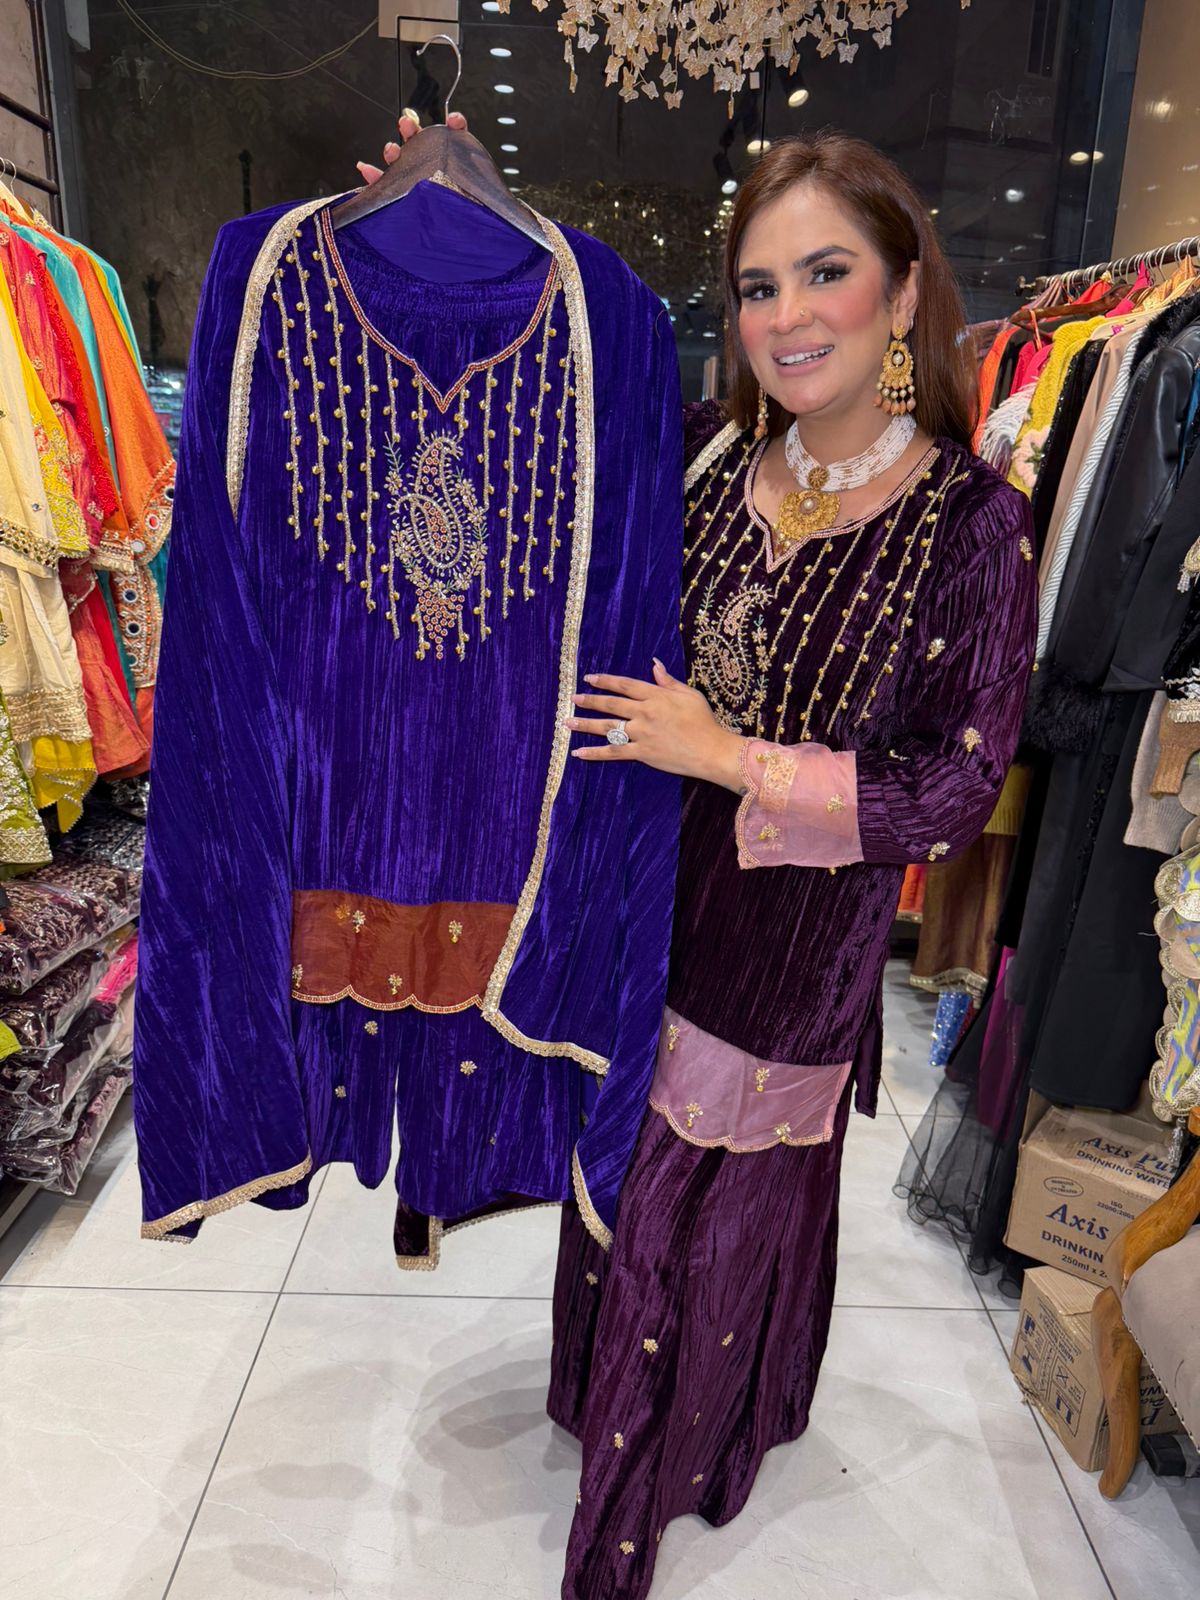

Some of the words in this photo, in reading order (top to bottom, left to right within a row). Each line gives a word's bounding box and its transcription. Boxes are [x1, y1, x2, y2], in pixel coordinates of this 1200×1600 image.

[1083, 1137, 1132, 1158] Axis
[1076, 1150, 1133, 1176] DRINKING
[1111, 1200, 1123, 1209] ISO
[1045, 1203, 1110, 1240] Axis
[1041, 1230, 1104, 1264] DRINKIN
[1062, 1254, 1090, 1272] 250ml
